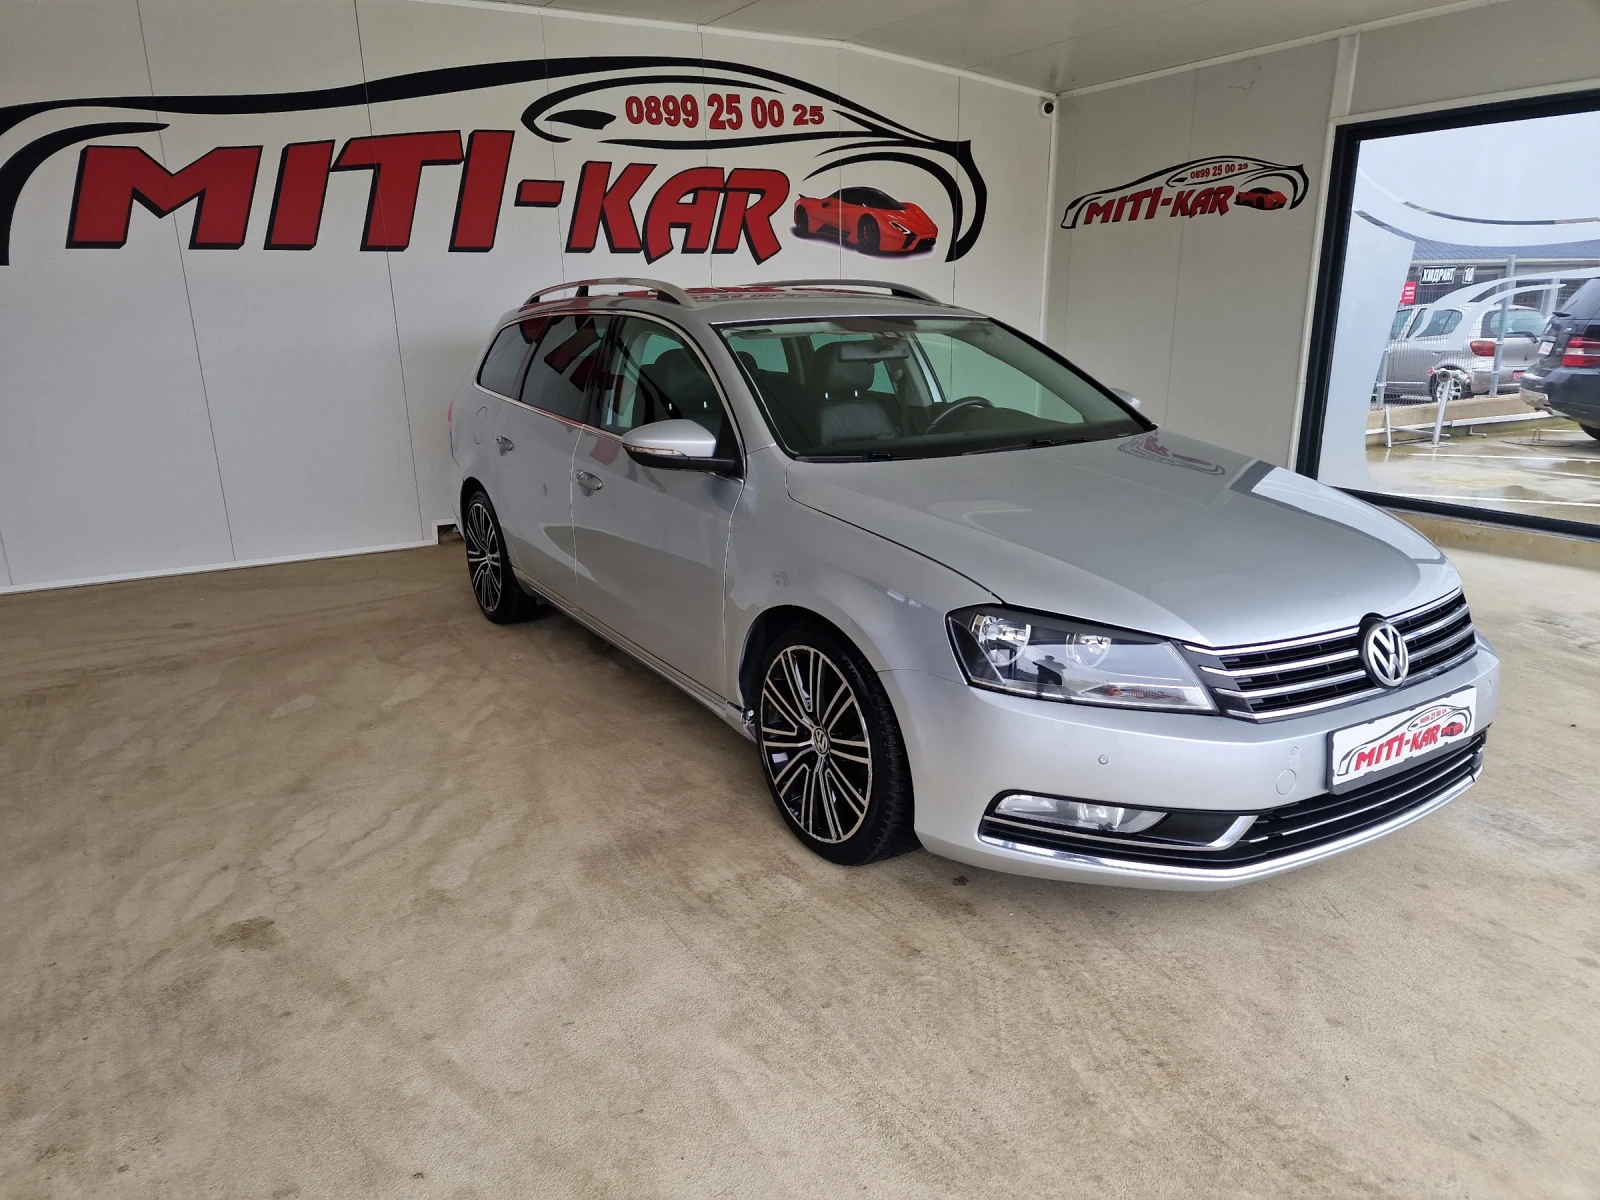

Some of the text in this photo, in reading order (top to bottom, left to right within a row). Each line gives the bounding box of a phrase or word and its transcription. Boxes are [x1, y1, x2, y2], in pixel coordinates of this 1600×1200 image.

[625, 93, 825, 130] 0899 25 00 25
[1190, 162, 1249, 179] 0899 25 00 25
[65, 129, 791, 266] MITI-KAR
[1083, 185, 1235, 225] MITI-KAR
[1422, 267, 1474, 282] ХИДРАНТ 10
[1354, 724, 1441, 771] MITI-KAR
